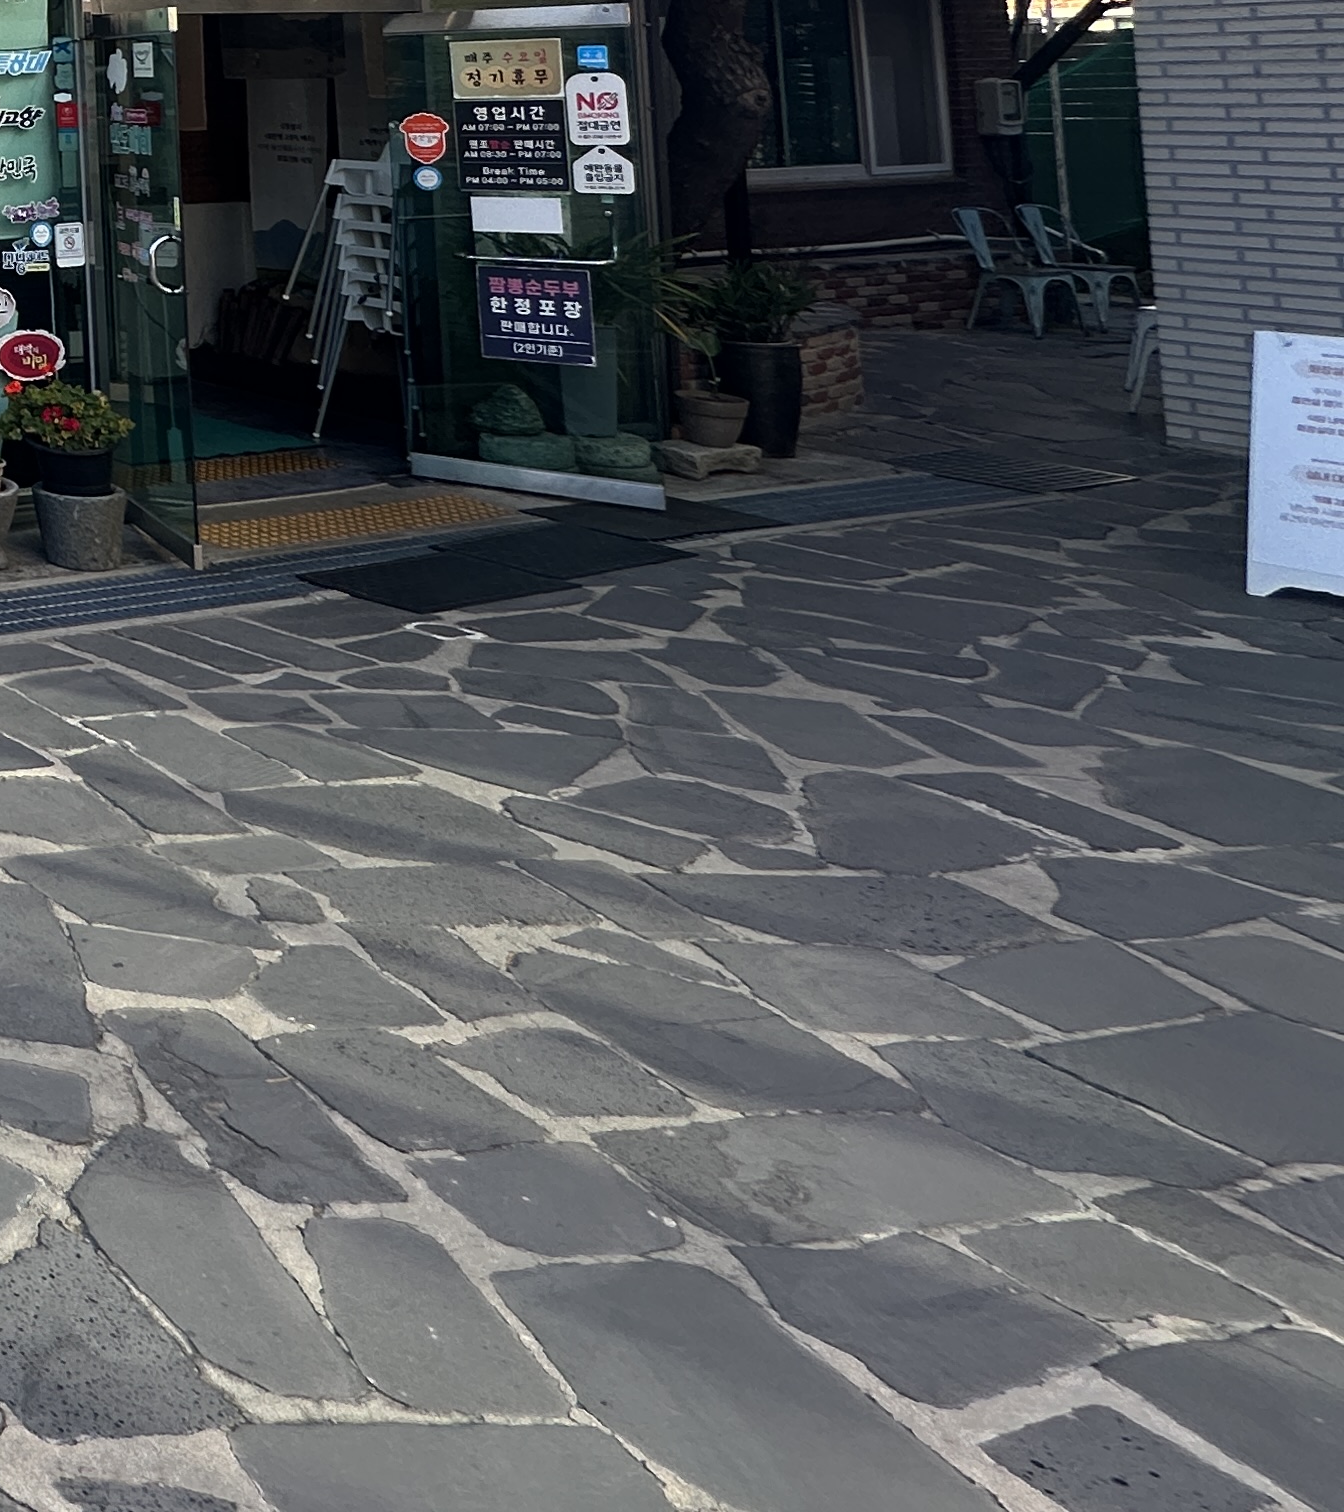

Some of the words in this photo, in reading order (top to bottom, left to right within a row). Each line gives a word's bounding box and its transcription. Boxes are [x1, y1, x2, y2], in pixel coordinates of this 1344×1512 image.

[464, 51, 494, 64] 매주
[501, 48, 548, 65] 수요일
[464, 68, 549, 88] 정기휴무
[576, 91, 620, 112] NO
[472, 105, 546, 122] 영업시간
[462, 123, 477, 132] AM
[516, 123, 530, 132] PM
[463, 151, 478, 159] AM
[518, 151, 533, 159] PM
[482, 166, 515, 176] Break
[517, 166, 546, 177] Time
[465, 176, 480, 185] PM
[519, 176, 535, 185] PM
[489, 296, 583, 319] 한정포장
[499, 319, 575, 337] 판매합니다.
